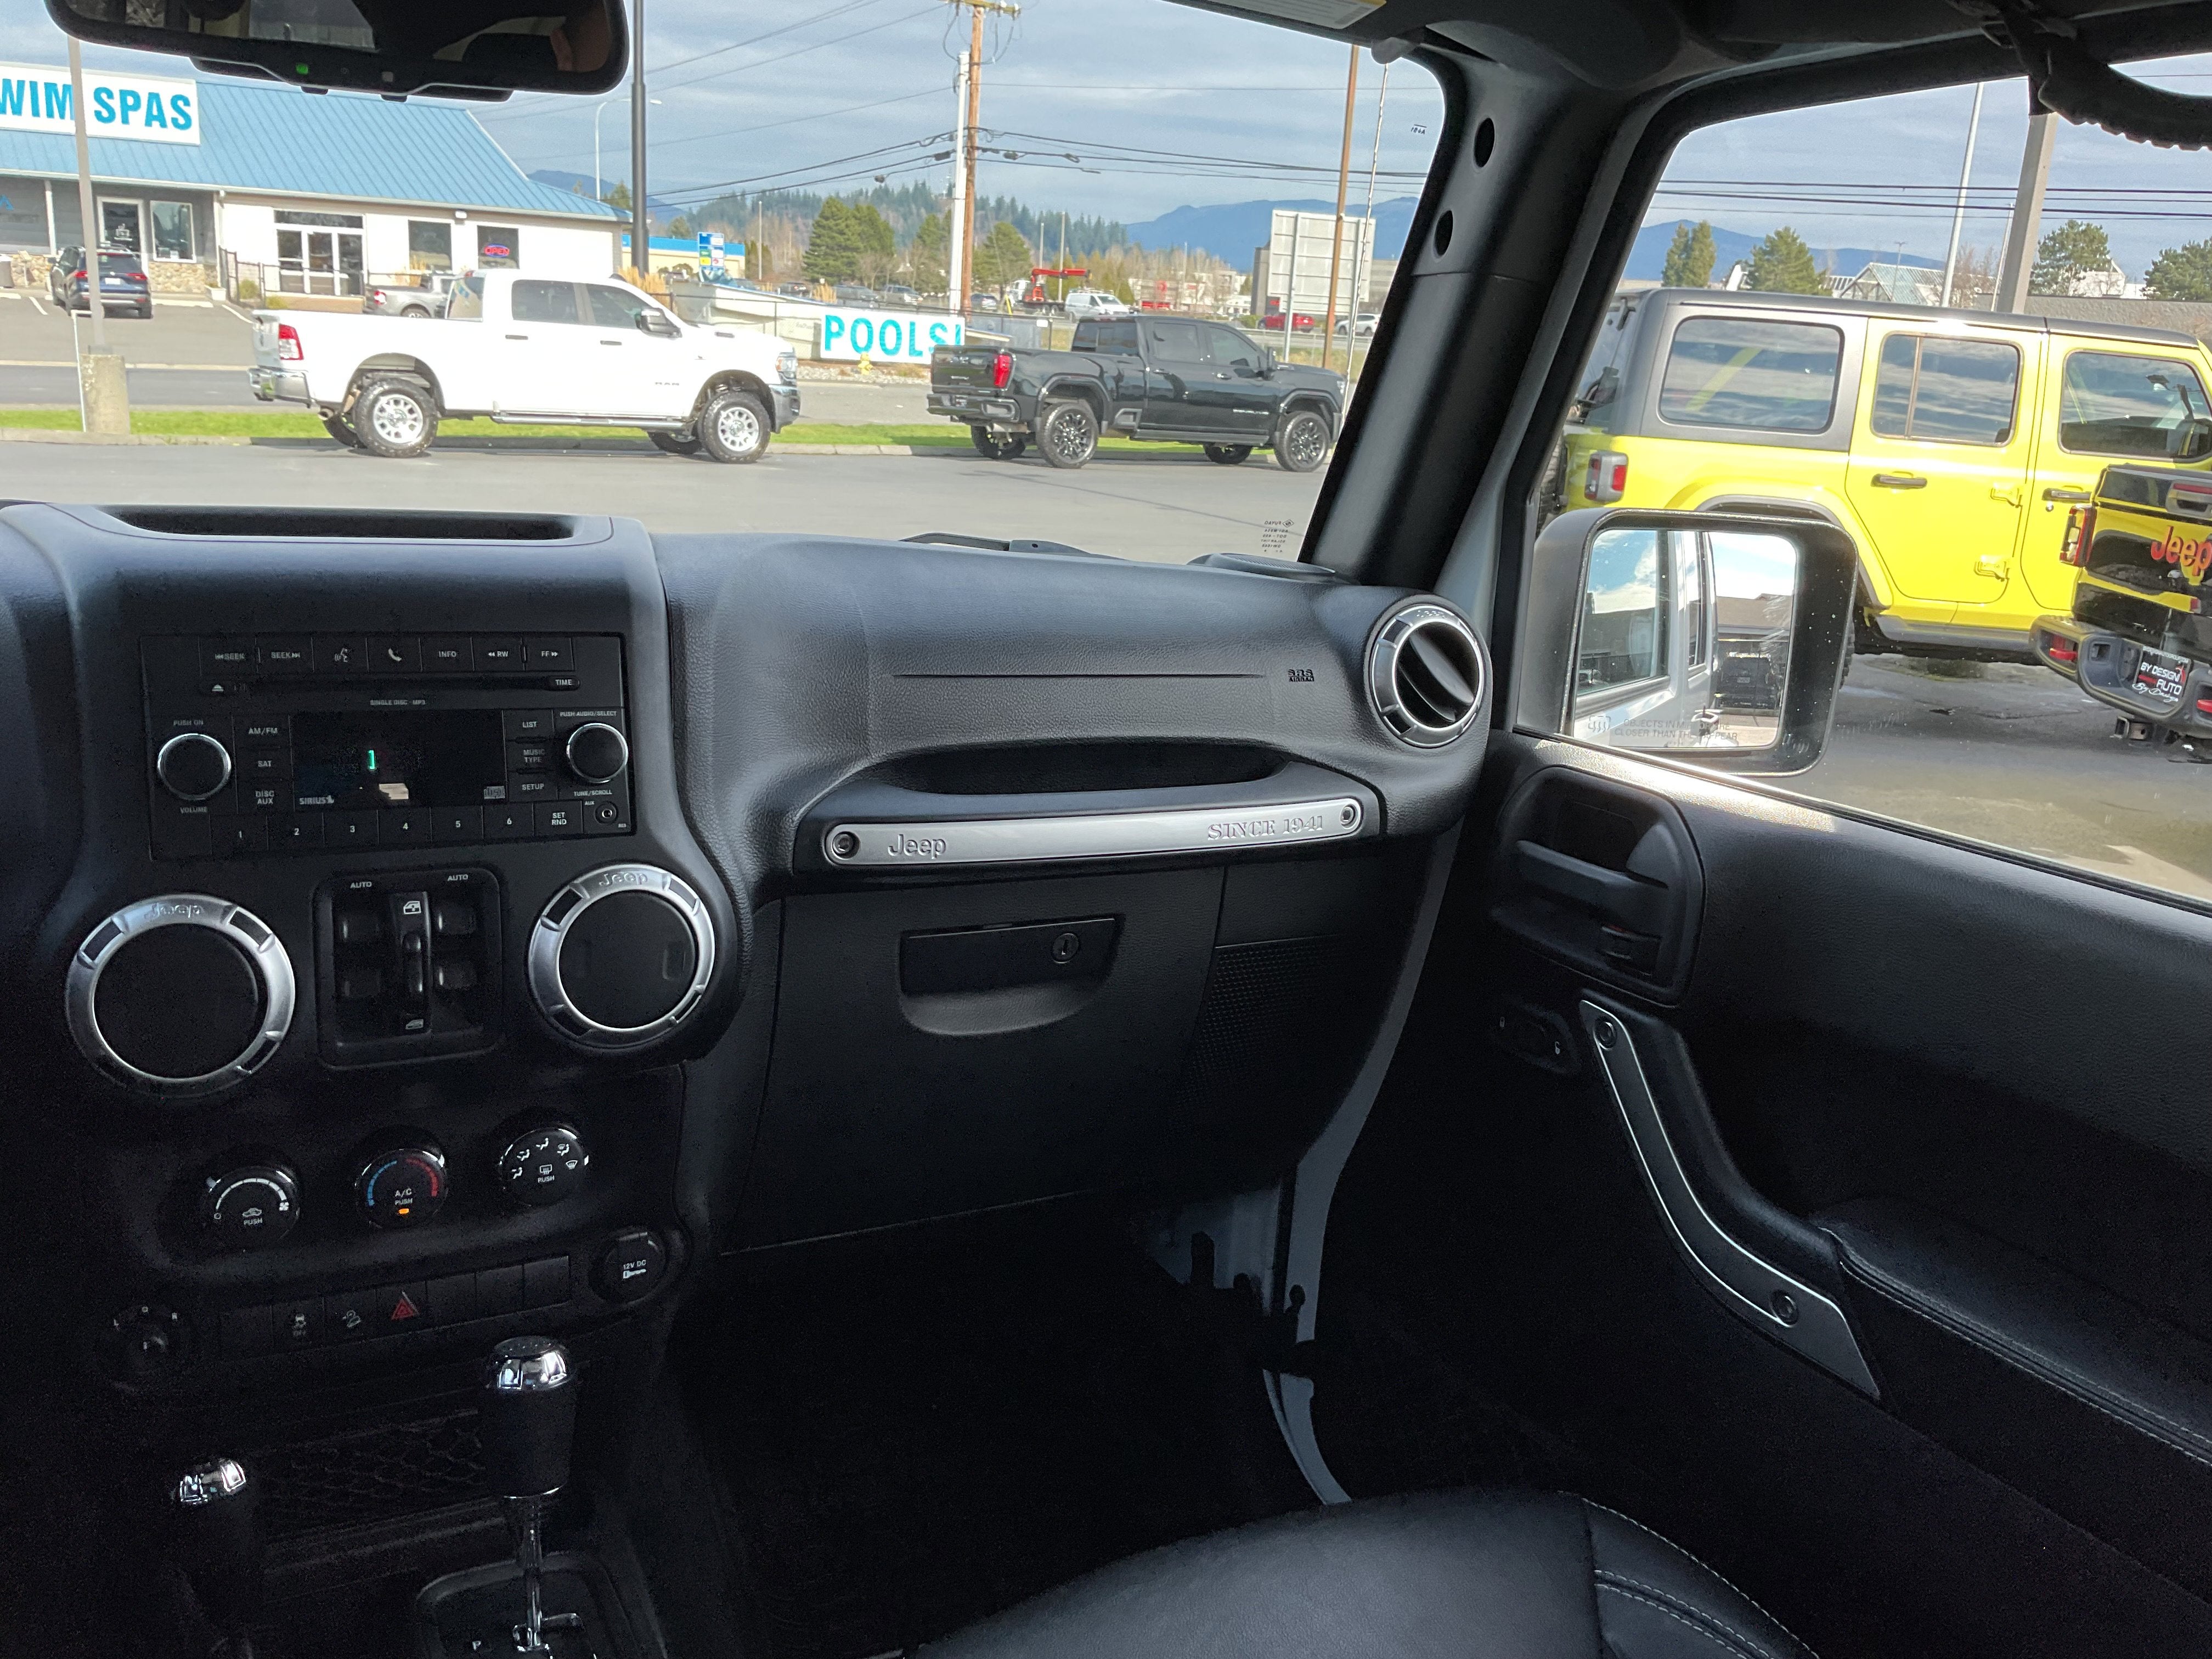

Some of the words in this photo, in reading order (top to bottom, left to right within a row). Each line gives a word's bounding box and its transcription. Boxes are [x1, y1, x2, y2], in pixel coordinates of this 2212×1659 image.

[93, 87, 192, 131] SPAS
[484, 246, 510, 255] OPEN
[2151, 525, 2212, 577] Jeep
[2141, 662, 2152, 672] BY
[2151, 665, 2181, 682] DESIGN
[2156, 679, 2182, 695] AUTO
[1666, 720, 1674, 729] IN
[1614, 728, 1649, 737] CLOSER
[1653, 729, 1675, 738] THAN
[180, 806, 208, 814] VOLUME
[455, 820, 461, 828] 5
[506, 817, 512, 825] 6
[1207, 820, 1275, 840] SINCE
[1282, 815, 1323, 834] 1941
[239, 831, 242, 839] 1
[888, 834, 946, 859] Jeep
[599, 873, 648, 887] Jeep
[538, 1175, 555, 1183] PUSH
[395, 1187, 412, 1198] A/C
[395, 1198, 413, 1206] PUSH
[243, 1217, 263, 1226] PUSH
[623, 1262, 635, 1270] 12V
[636, 1259, 647, 1267] DC
[472, 1640, 482, 1651] P
